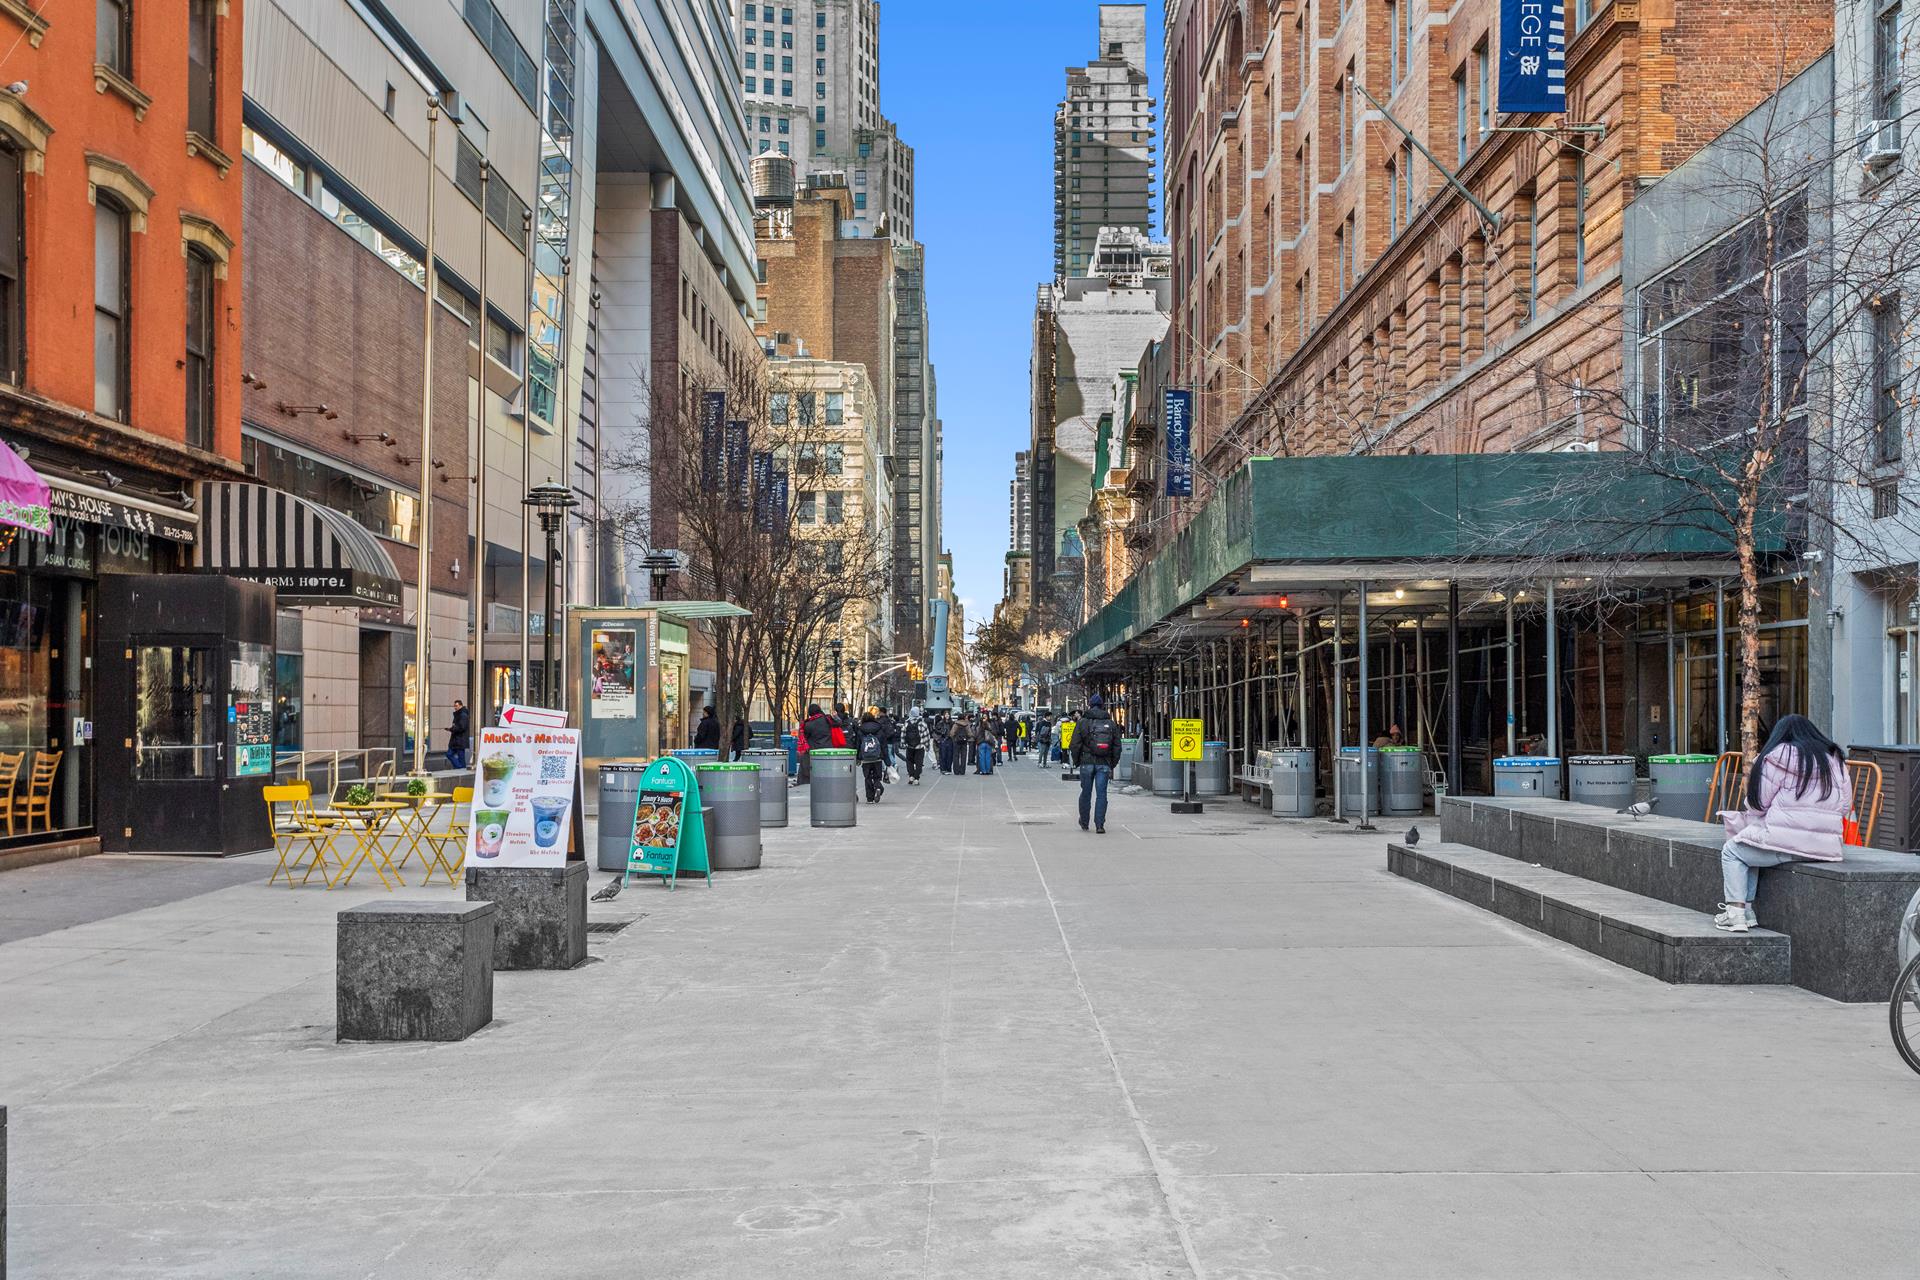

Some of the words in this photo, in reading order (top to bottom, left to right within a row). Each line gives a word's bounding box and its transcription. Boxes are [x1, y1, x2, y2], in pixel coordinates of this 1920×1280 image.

[1521, 0, 1541, 47] EGE
[1173, 399, 1184, 436] Baruch
[78, 495, 113, 517] HOUSE
[51, 507, 67, 516] ASIAN
[70, 510, 90, 522] NOODLE
[43, 553, 66, 566] ASIAN
[67, 557, 91, 570] CUISINE
[264, 576, 295, 587] ARMS
[649, 618, 657, 666] Newsstand
[483, 733, 532, 743] MuCha's
[534, 733, 576, 745] Matcha
[651, 776, 676, 785] Fantuan
[641, 795, 660, 804] Jimmy's
[646, 851, 673, 860] Fantuan
